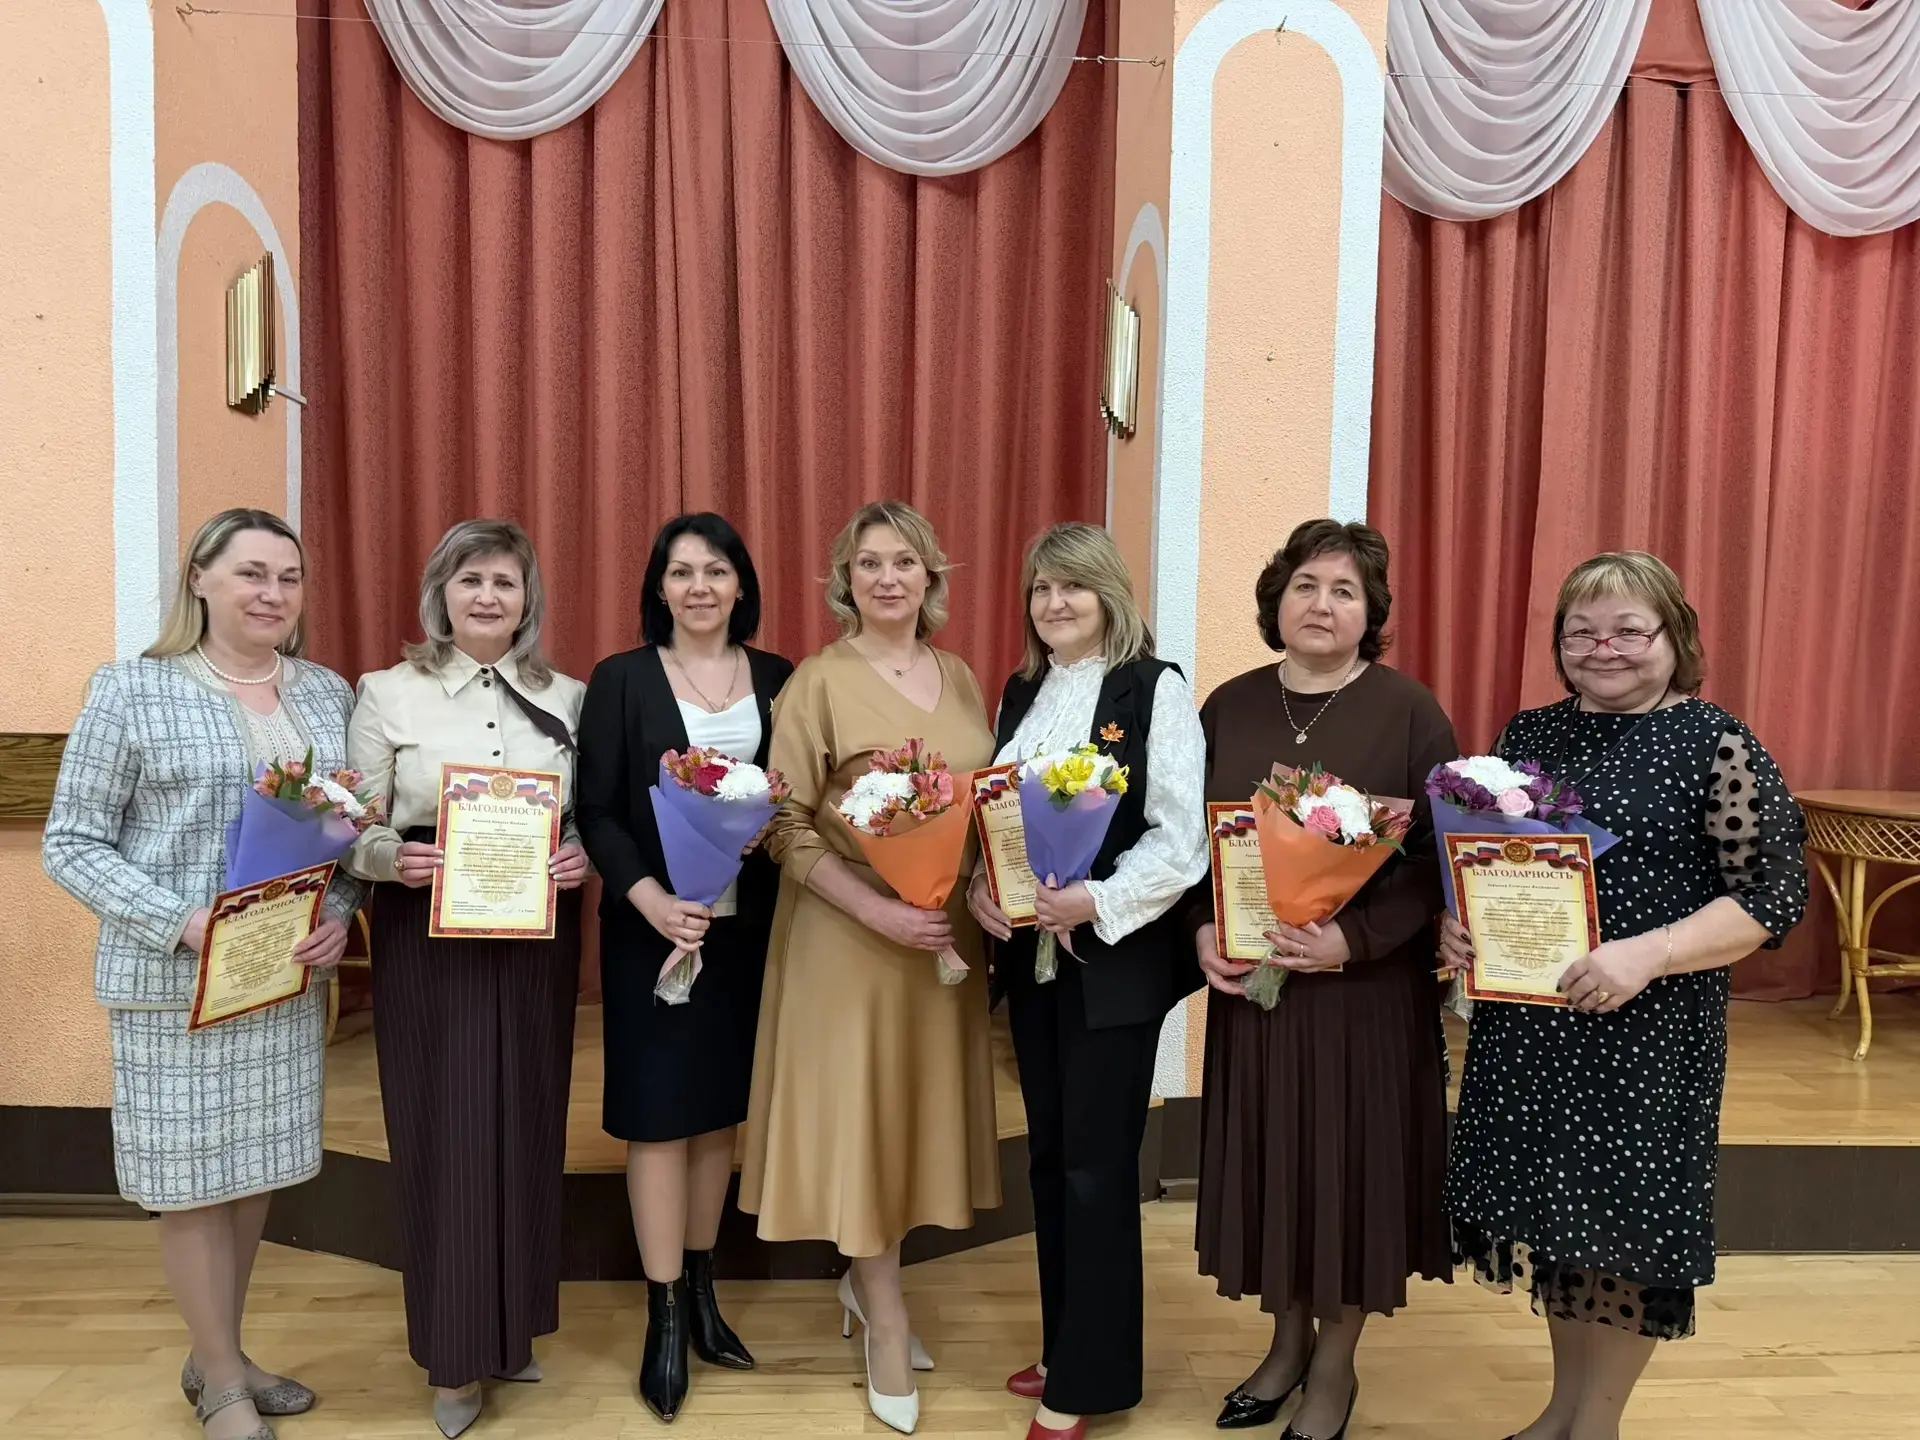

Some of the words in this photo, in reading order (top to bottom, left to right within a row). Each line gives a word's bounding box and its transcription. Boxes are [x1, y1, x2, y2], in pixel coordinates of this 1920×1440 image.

[458, 801, 544, 816] БЛАГОДАРНОСТЬ
[1472, 867, 1573, 880] БЛАГОДАРНОСТЬ
[224, 894, 310, 925] БЛАГОДАРНОСТЬ
